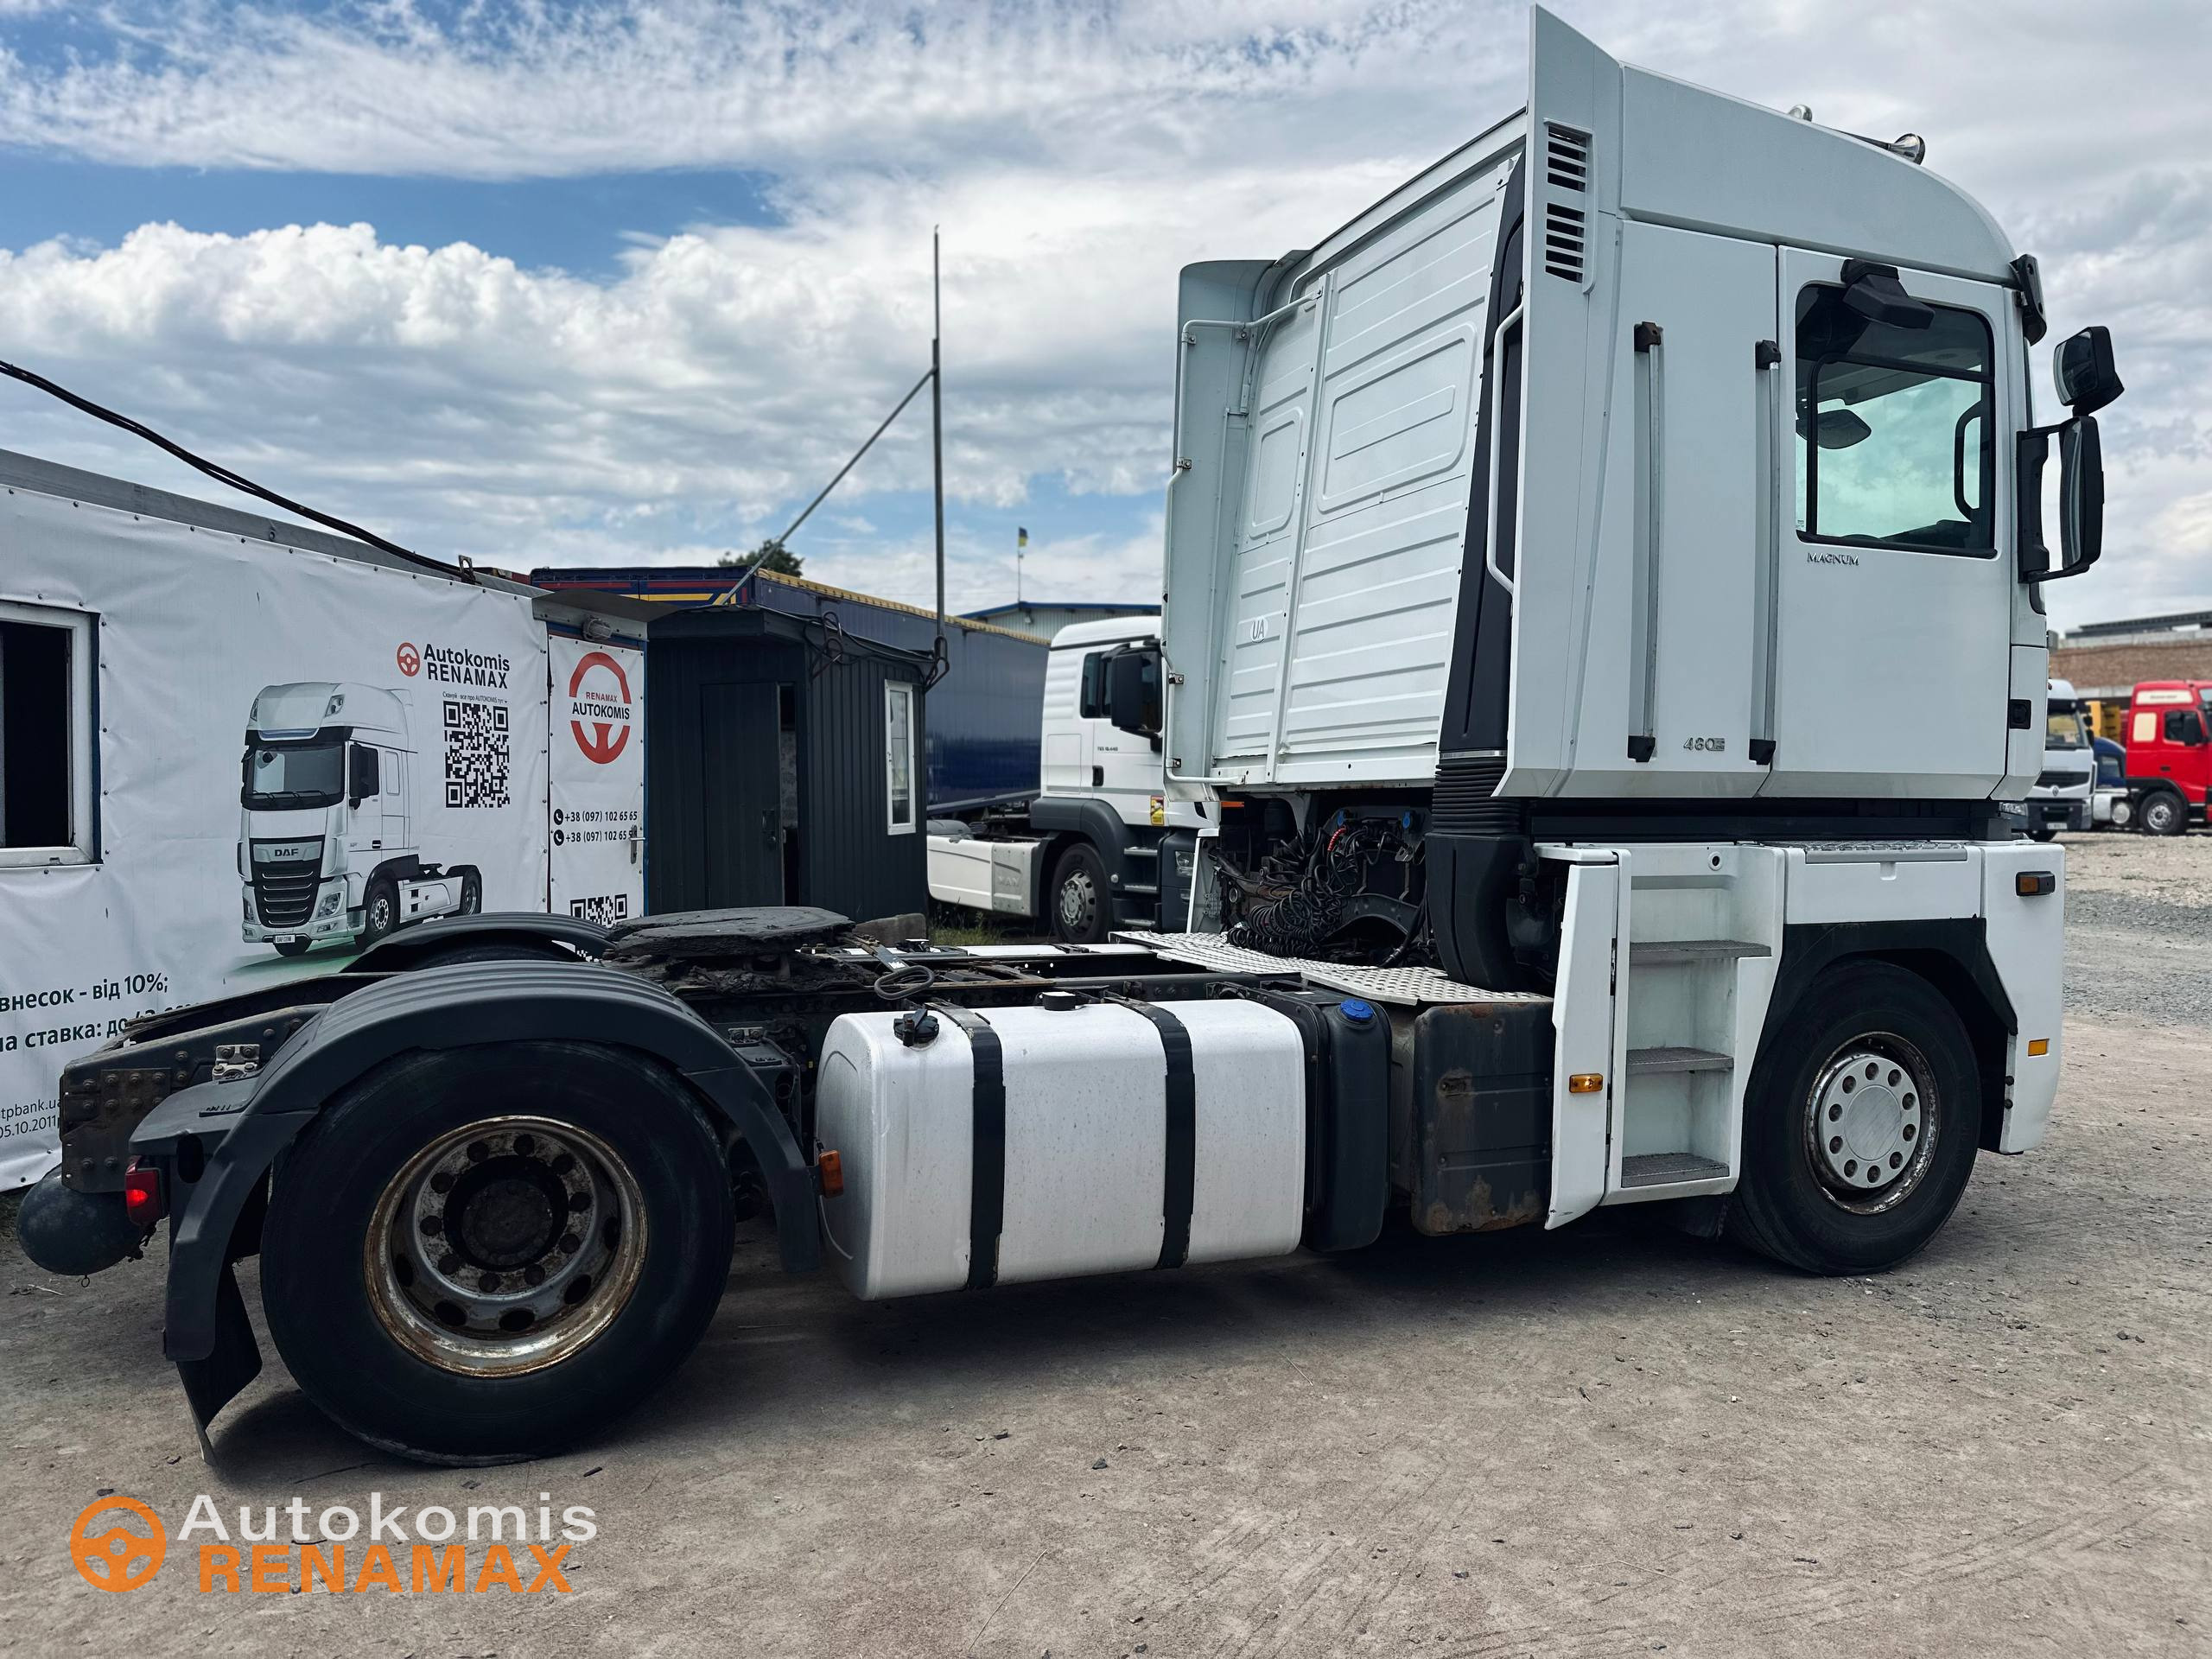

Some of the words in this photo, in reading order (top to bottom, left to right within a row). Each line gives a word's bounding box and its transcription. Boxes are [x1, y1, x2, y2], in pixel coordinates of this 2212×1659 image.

[1807, 553, 1859, 566] MAGNUM
[1252, 620, 1265, 640] UA
[423, 644, 510, 671] Autokomis
[428, 662, 508, 689] RENAMAX
[586, 692, 618, 702] RENAMAX
[572, 702, 630, 720] AUTOKOMIS
[564, 811, 581, 822] +38
[582, 810, 603, 823] (097)
[605, 811, 618, 822] 102
[620, 811, 627, 821] 65
[629, 811, 638, 820] 65
[566, 831, 582, 842] +38
[583, 830, 602, 842] (097)
[605, 830, 617, 841] 102
[619, 830, 627, 840] 65
[274, 848, 299, 856] DAF
[0, 988, 74, 1012] внесок
[92, 978, 121, 1001] від
[124, 972, 168, 995] 10%;
[25, 1022, 102, 1048] ставка:
